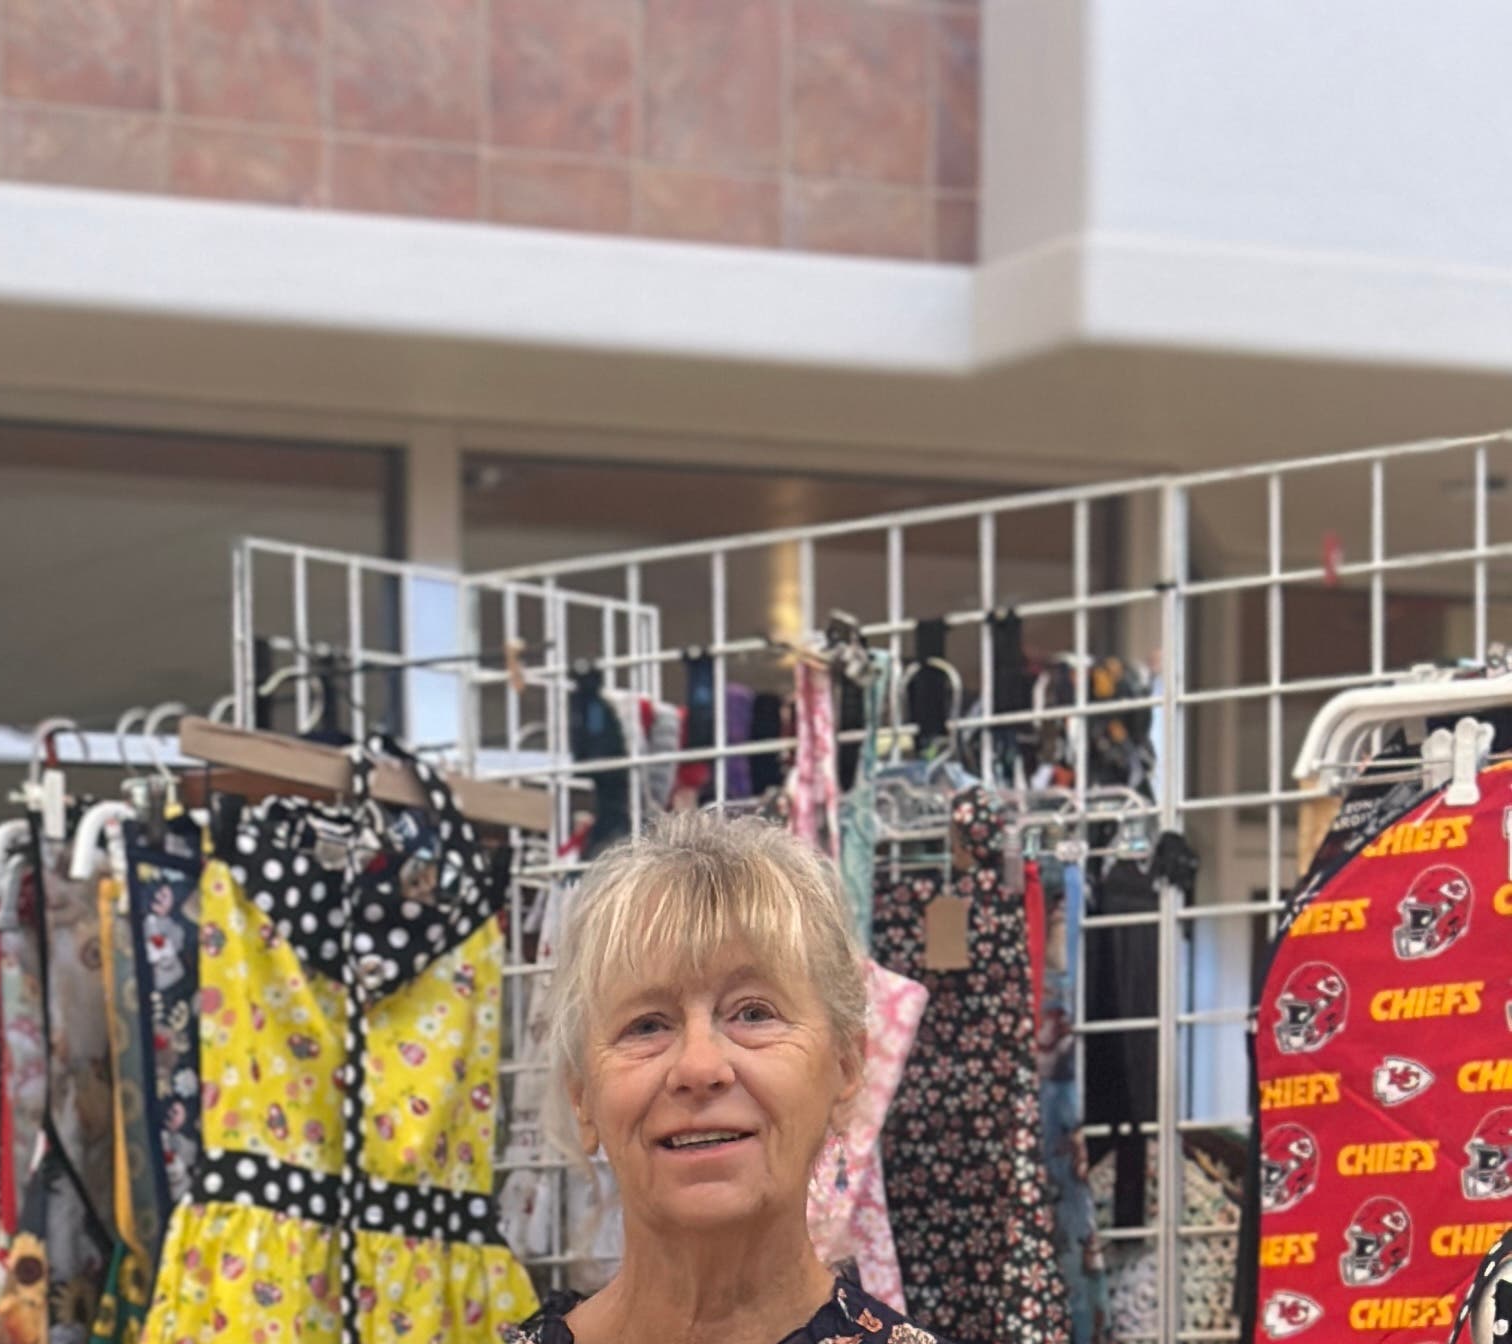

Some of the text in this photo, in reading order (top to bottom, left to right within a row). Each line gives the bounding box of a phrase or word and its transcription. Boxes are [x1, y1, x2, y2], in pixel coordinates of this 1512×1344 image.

[1370, 981, 1484, 1021] CHIEFS
[1260, 1073, 1341, 1110] HIEFS
[1337, 1140, 1439, 1176] CHIEFS
[1349, 1294, 1455, 1330] CHIEFS
